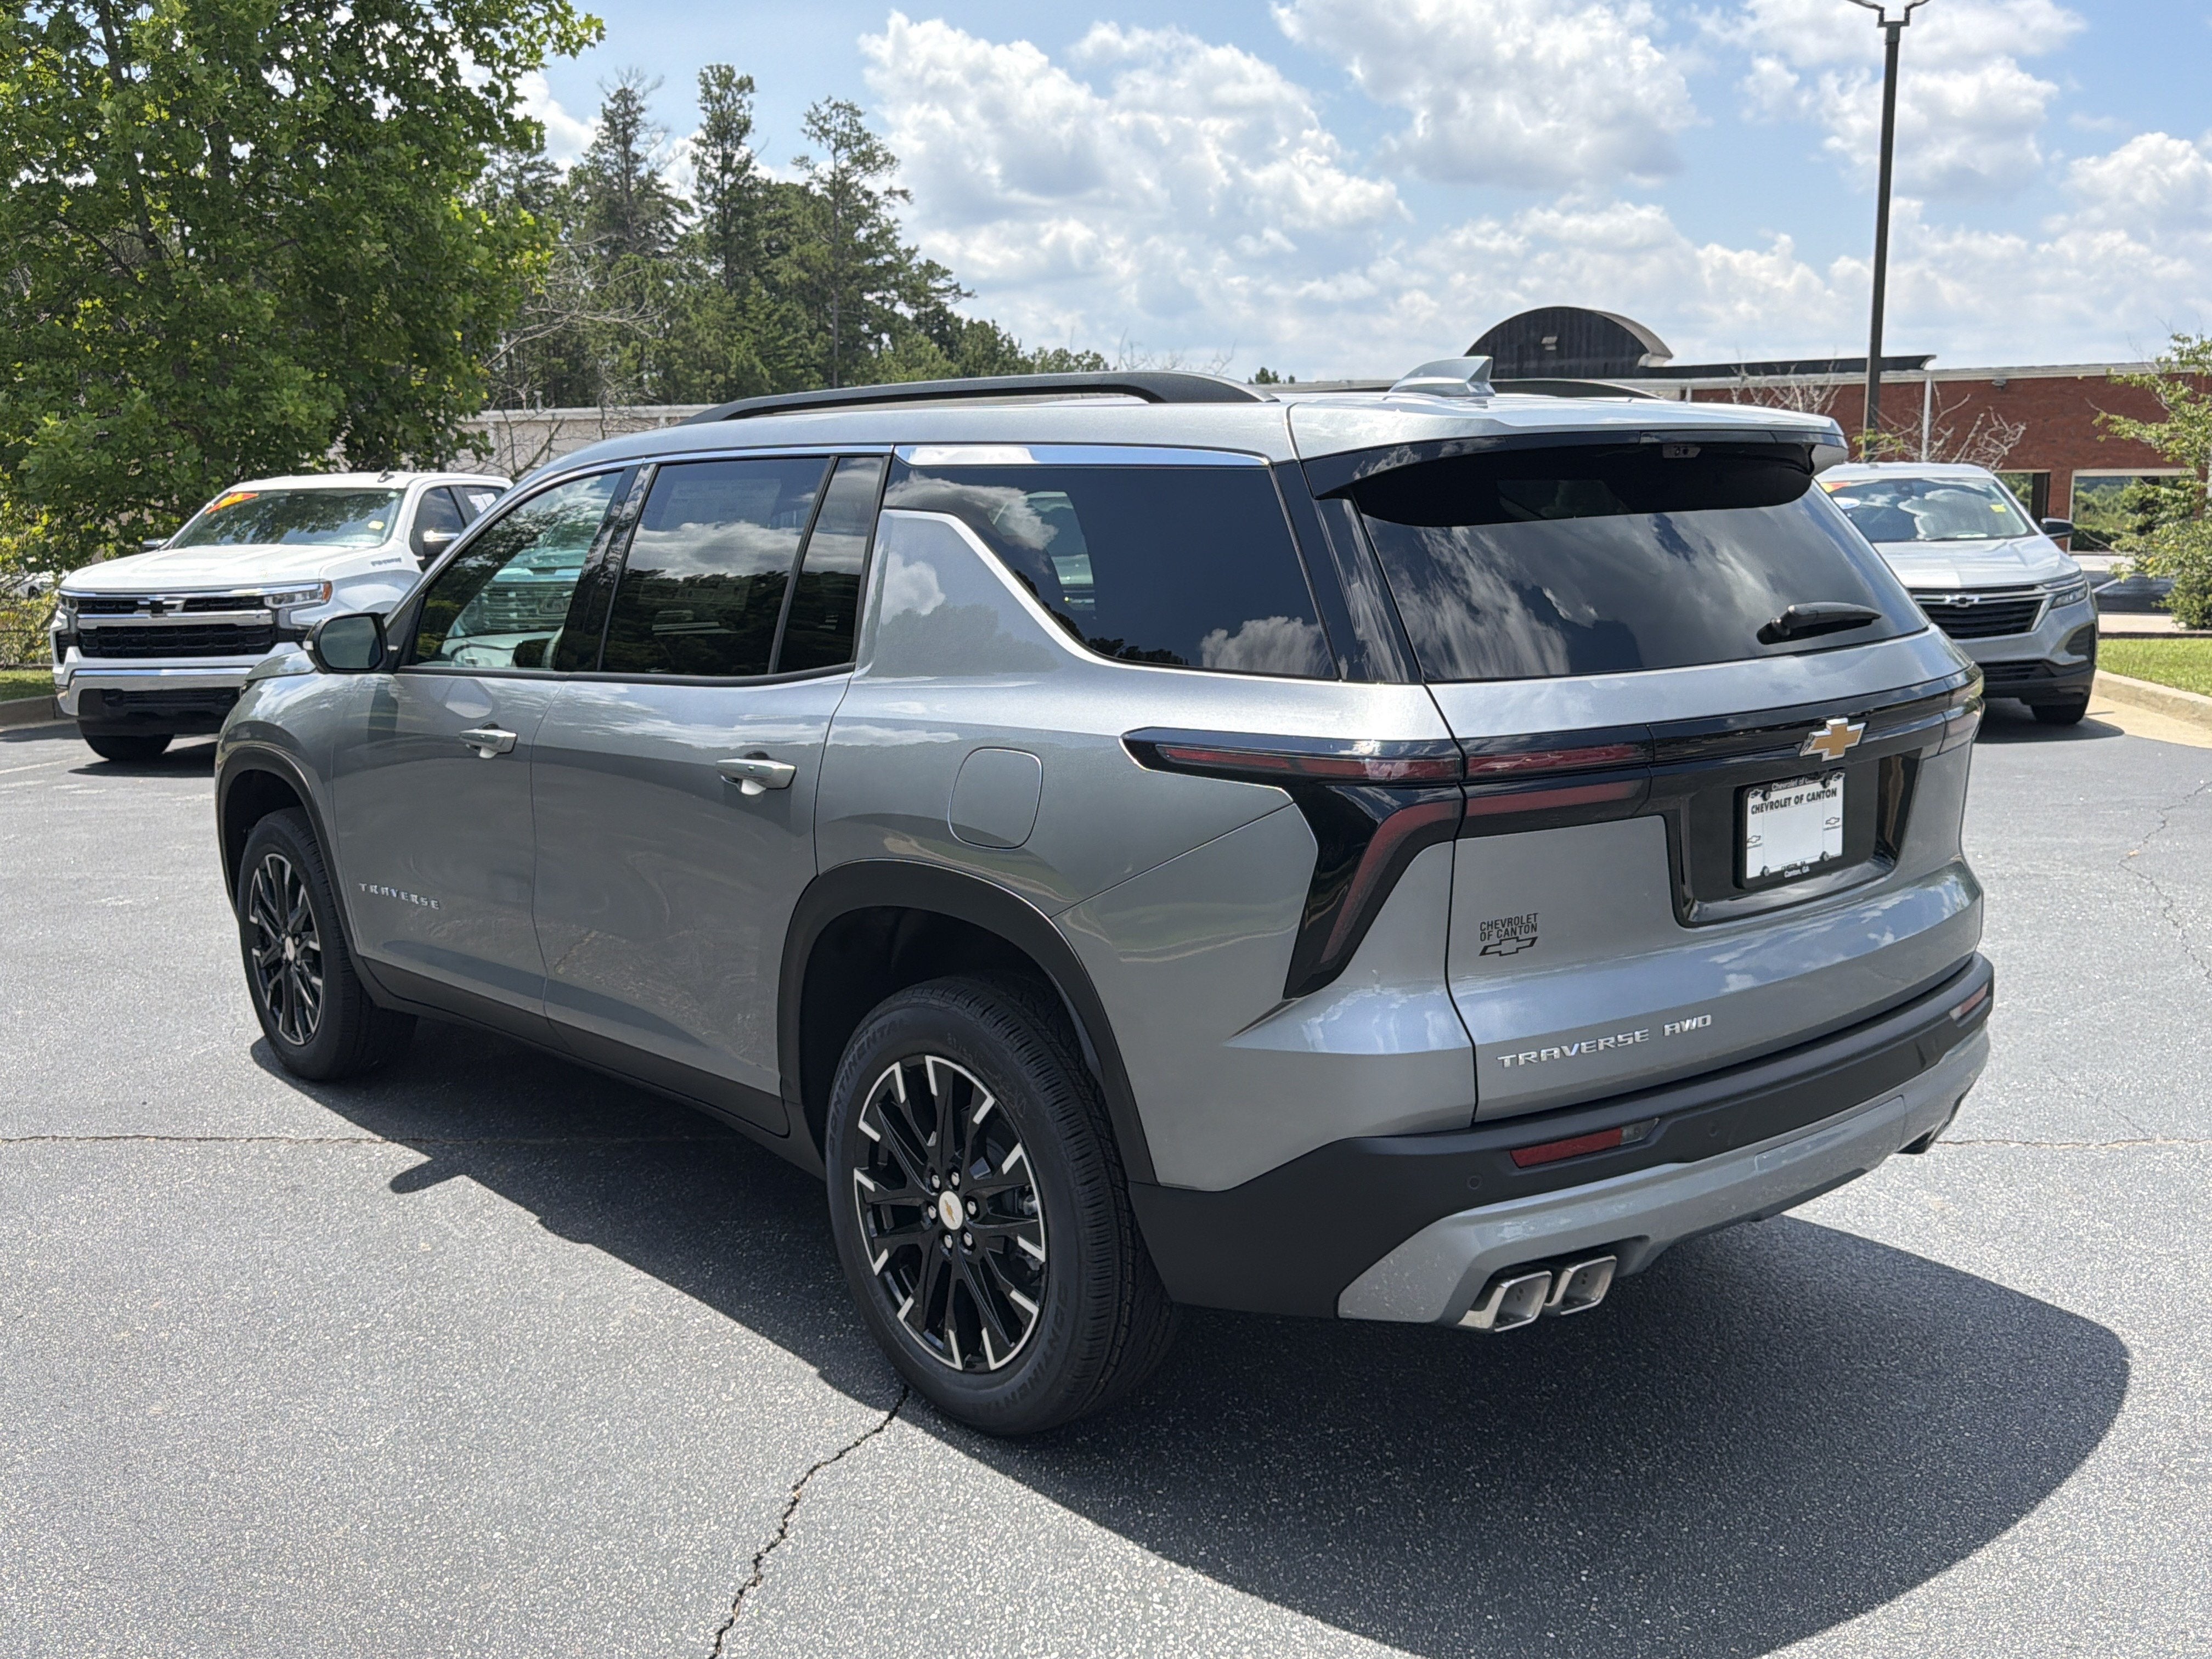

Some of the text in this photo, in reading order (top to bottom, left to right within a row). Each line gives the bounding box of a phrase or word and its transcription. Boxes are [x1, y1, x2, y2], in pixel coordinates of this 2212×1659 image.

[1751, 788, 1837, 814] CHEVROLET OF CANTON
[359, 883, 439, 910] TRAVERSE
[1480, 913, 1538, 932] CHEVROLET
[1480, 923, 1537, 941] OF CANTON
[1497, 1014, 1712, 1068] TRAVERSE AWD
